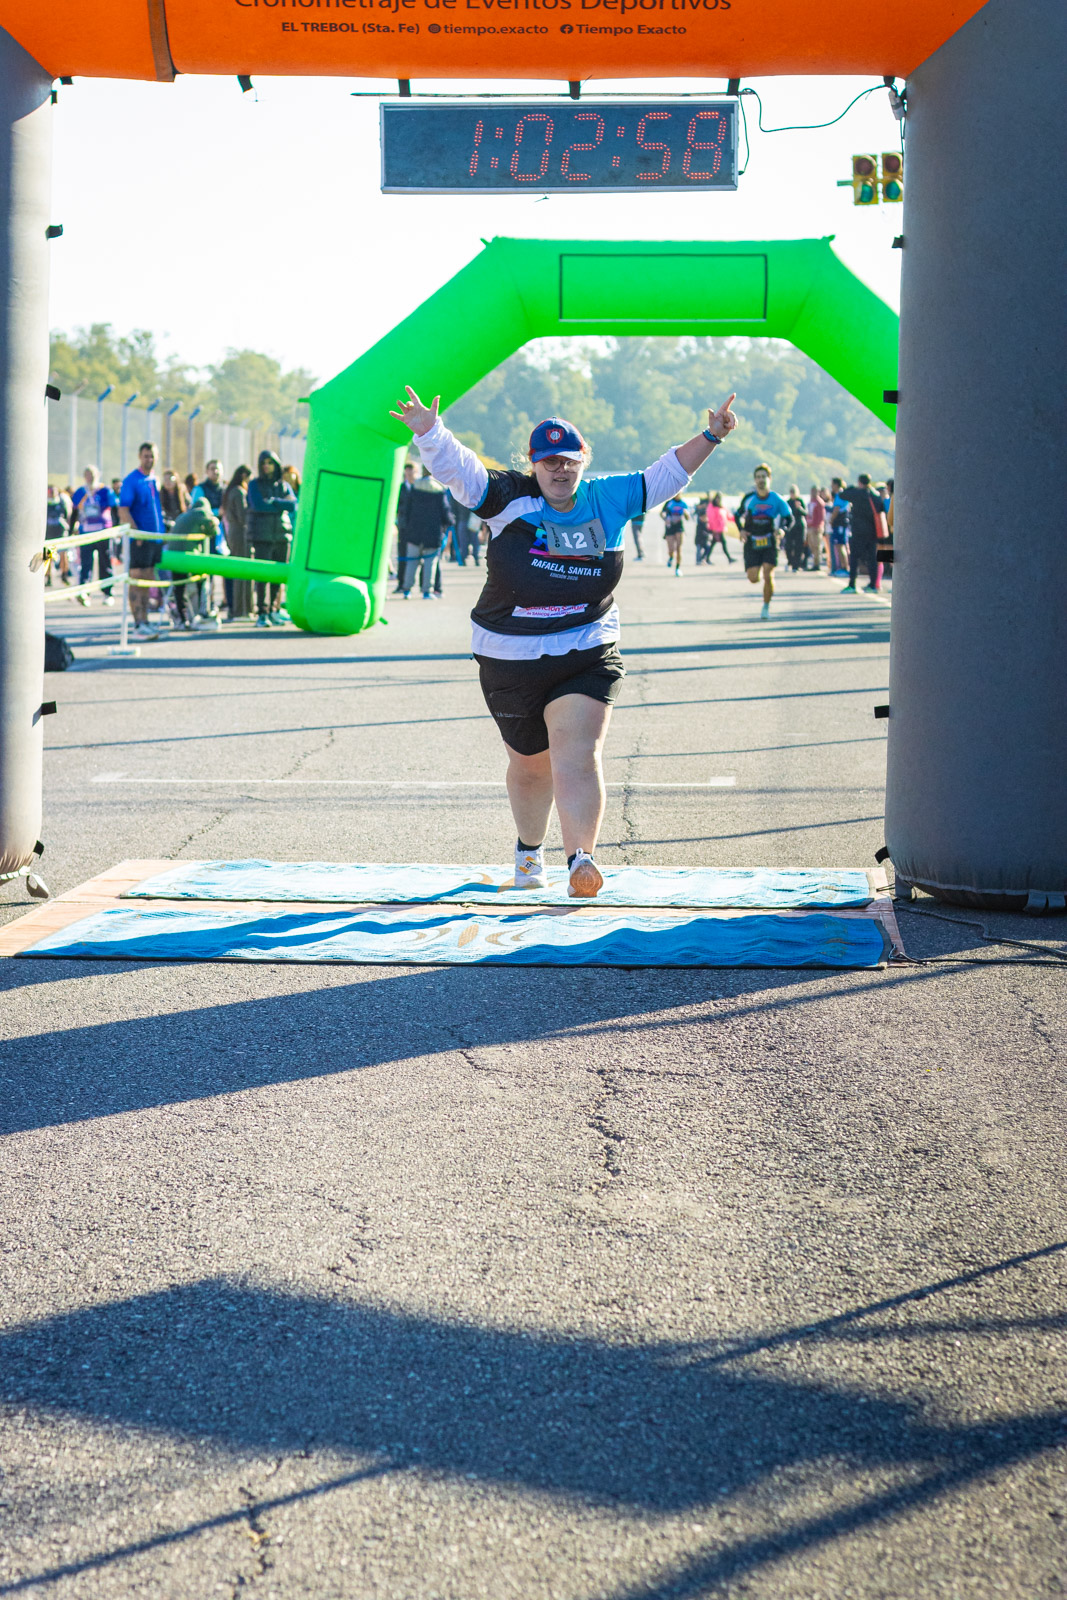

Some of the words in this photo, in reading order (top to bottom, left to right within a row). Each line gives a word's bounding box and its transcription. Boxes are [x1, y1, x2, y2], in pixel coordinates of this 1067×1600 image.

[281, 22, 299, 32] EL
[301, 22, 359, 33] TREBOL
[362, 23, 395, 34] (Sta.
[398, 23, 420, 34] Fe)
[443, 24, 549, 36] tiempo.exacto
[576, 24, 634, 36] Tiempo
[637, 24, 687, 35] Exacto
[469, 111, 727, 181] 1:02:58
[561, 531, 588, 549] 12
[530, 558, 566, 574] RAFAELA,
[567, 566, 592, 577] SANTA
[592, 568, 602, 577] FE
